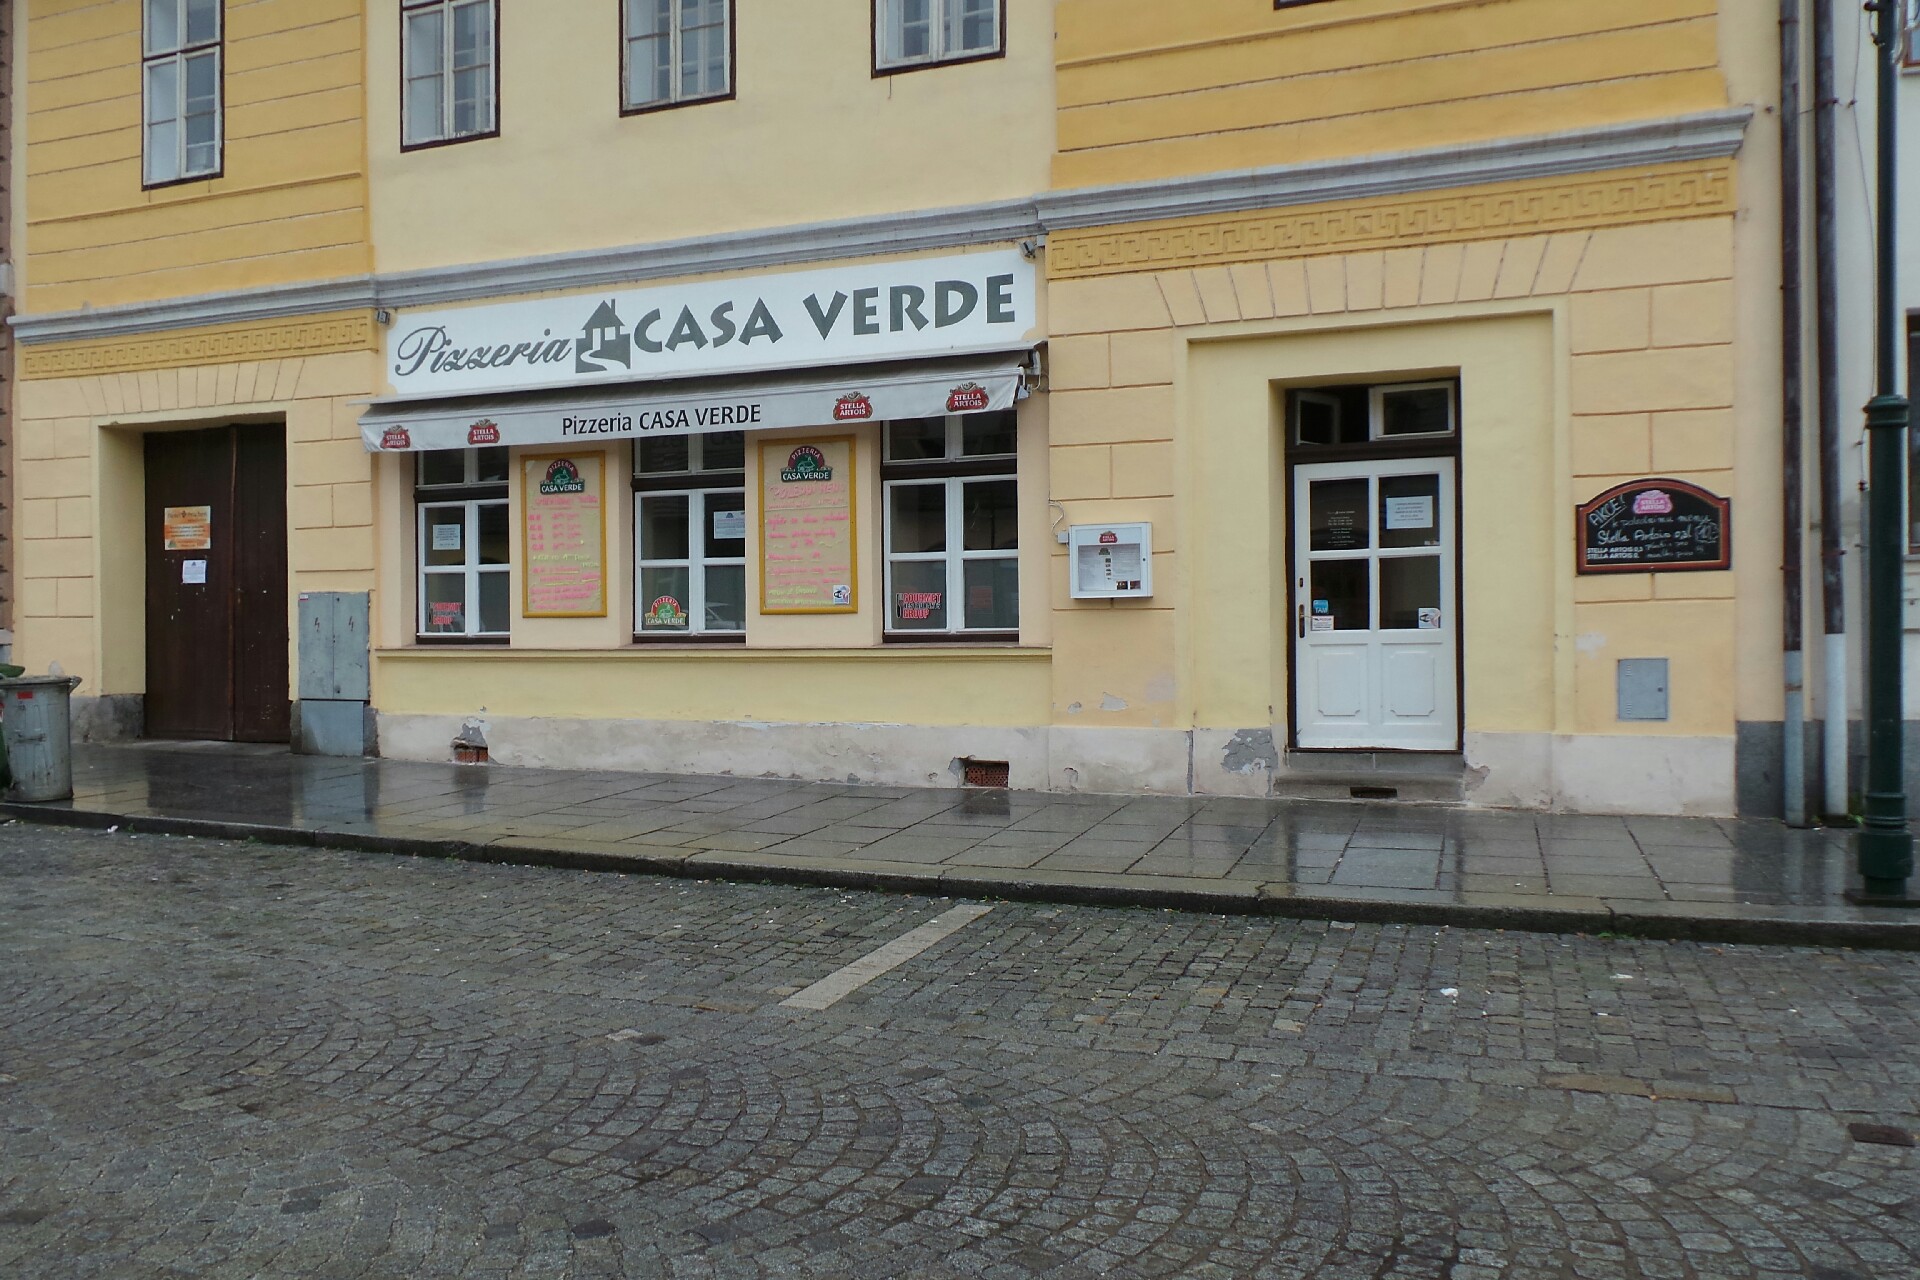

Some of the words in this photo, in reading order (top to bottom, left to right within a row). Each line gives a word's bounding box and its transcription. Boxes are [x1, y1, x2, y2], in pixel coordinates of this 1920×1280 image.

[394, 326, 572, 377] Pizzeria
[634, 297, 783, 354] CASA
[803, 273, 1015, 340] VERDE
[953, 392, 982, 401] STELLA
[839, 402, 866, 410] STELLA
[839, 408, 866, 416] ARTOIS
[562, 413, 632, 436] Pizzeria
[639, 410, 690, 429] CASA
[695, 404, 761, 426] VERDE
[791, 447, 821, 460] PIZZERIA
[549, 460, 575, 473] PIZZERIA
[782, 472, 802, 481] CASA
[803, 471, 830, 479] VERDE
[541, 485, 559, 493] CASA
[559, 483, 583, 492] VERDE
[654, 597, 677, 608] PIZZERIA
[903, 593, 942, 603] GOURMET
[903, 609, 930, 618] GROUP
